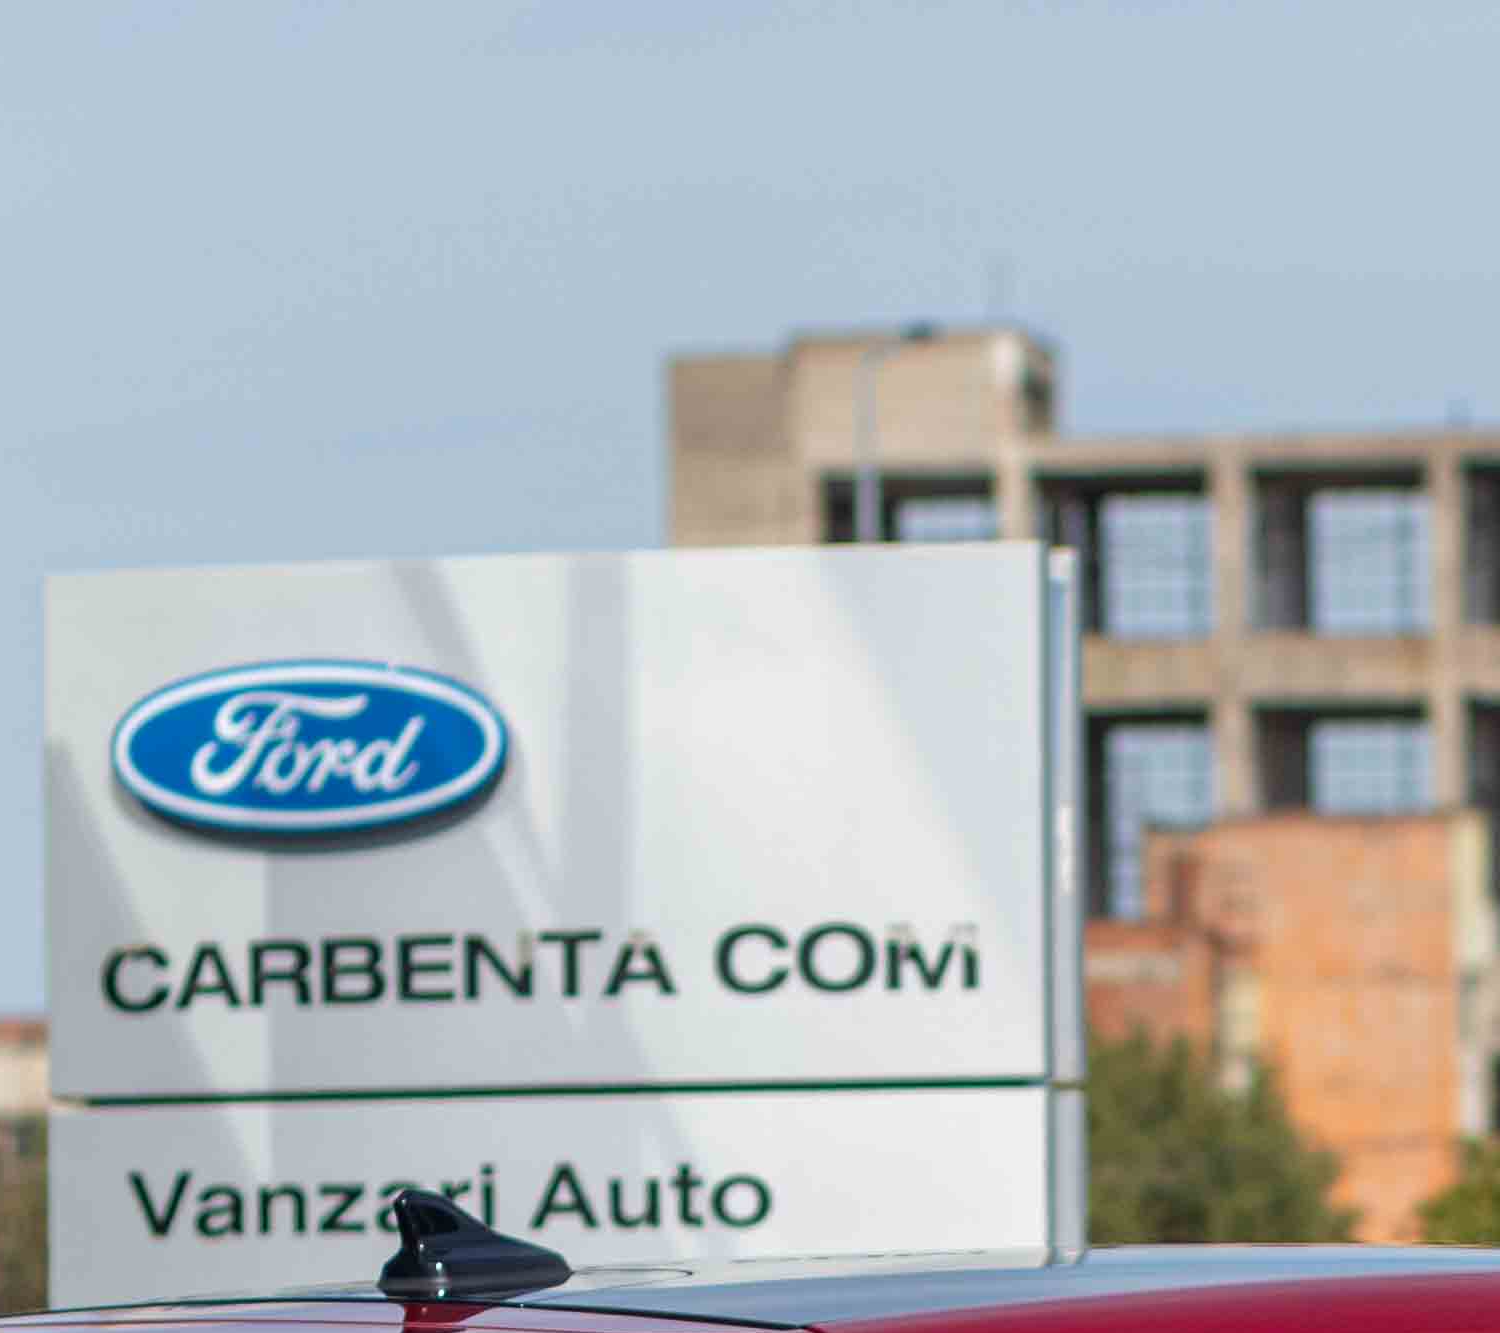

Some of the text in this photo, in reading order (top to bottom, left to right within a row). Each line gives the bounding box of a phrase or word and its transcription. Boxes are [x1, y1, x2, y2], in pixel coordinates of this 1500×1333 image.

[189, 690, 426, 794] Ford
[100, 922, 980, 1013] CARBENTA COM
[530, 1162, 773, 1230] Auto
